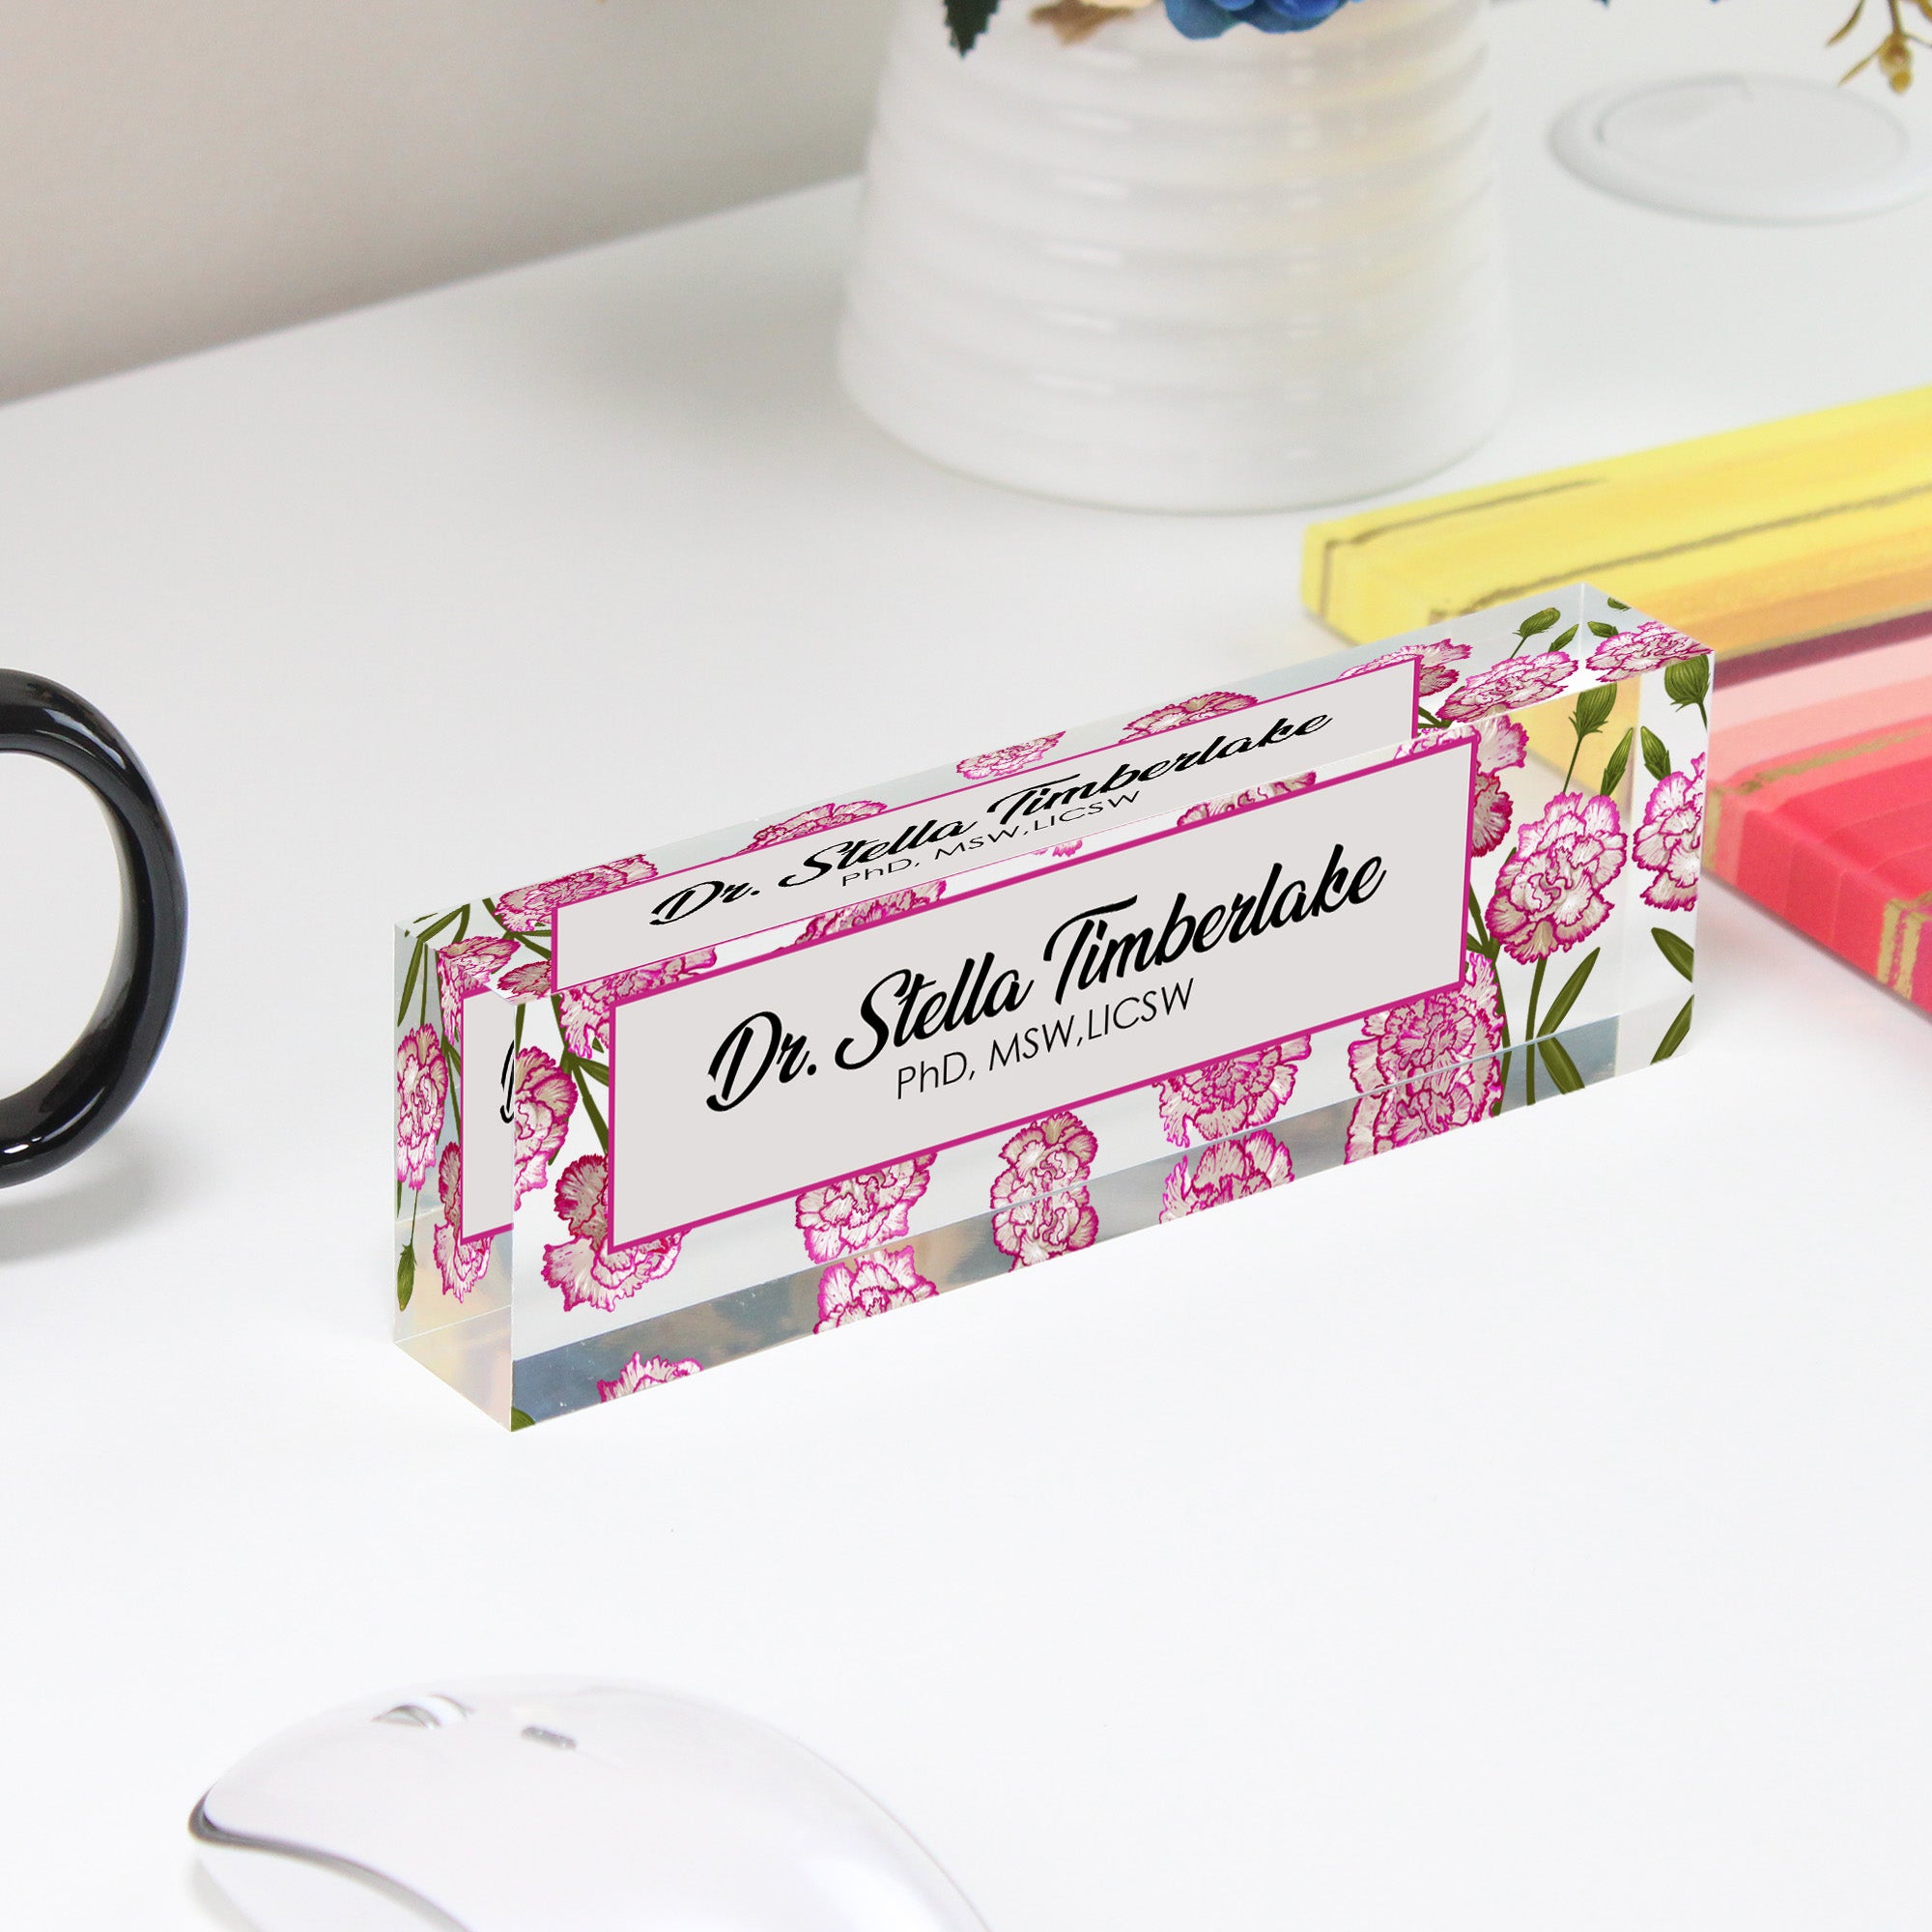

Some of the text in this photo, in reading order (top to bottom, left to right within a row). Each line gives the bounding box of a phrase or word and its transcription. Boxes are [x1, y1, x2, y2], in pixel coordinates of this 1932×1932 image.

[648, 714, 1333, 926] Dr. Stella Timberlake
[841, 859, 921, 887] PhD,
[705, 843, 1387, 1113] Dr. Stella Timberlake
[897, 1050, 976, 1100] PhD,
